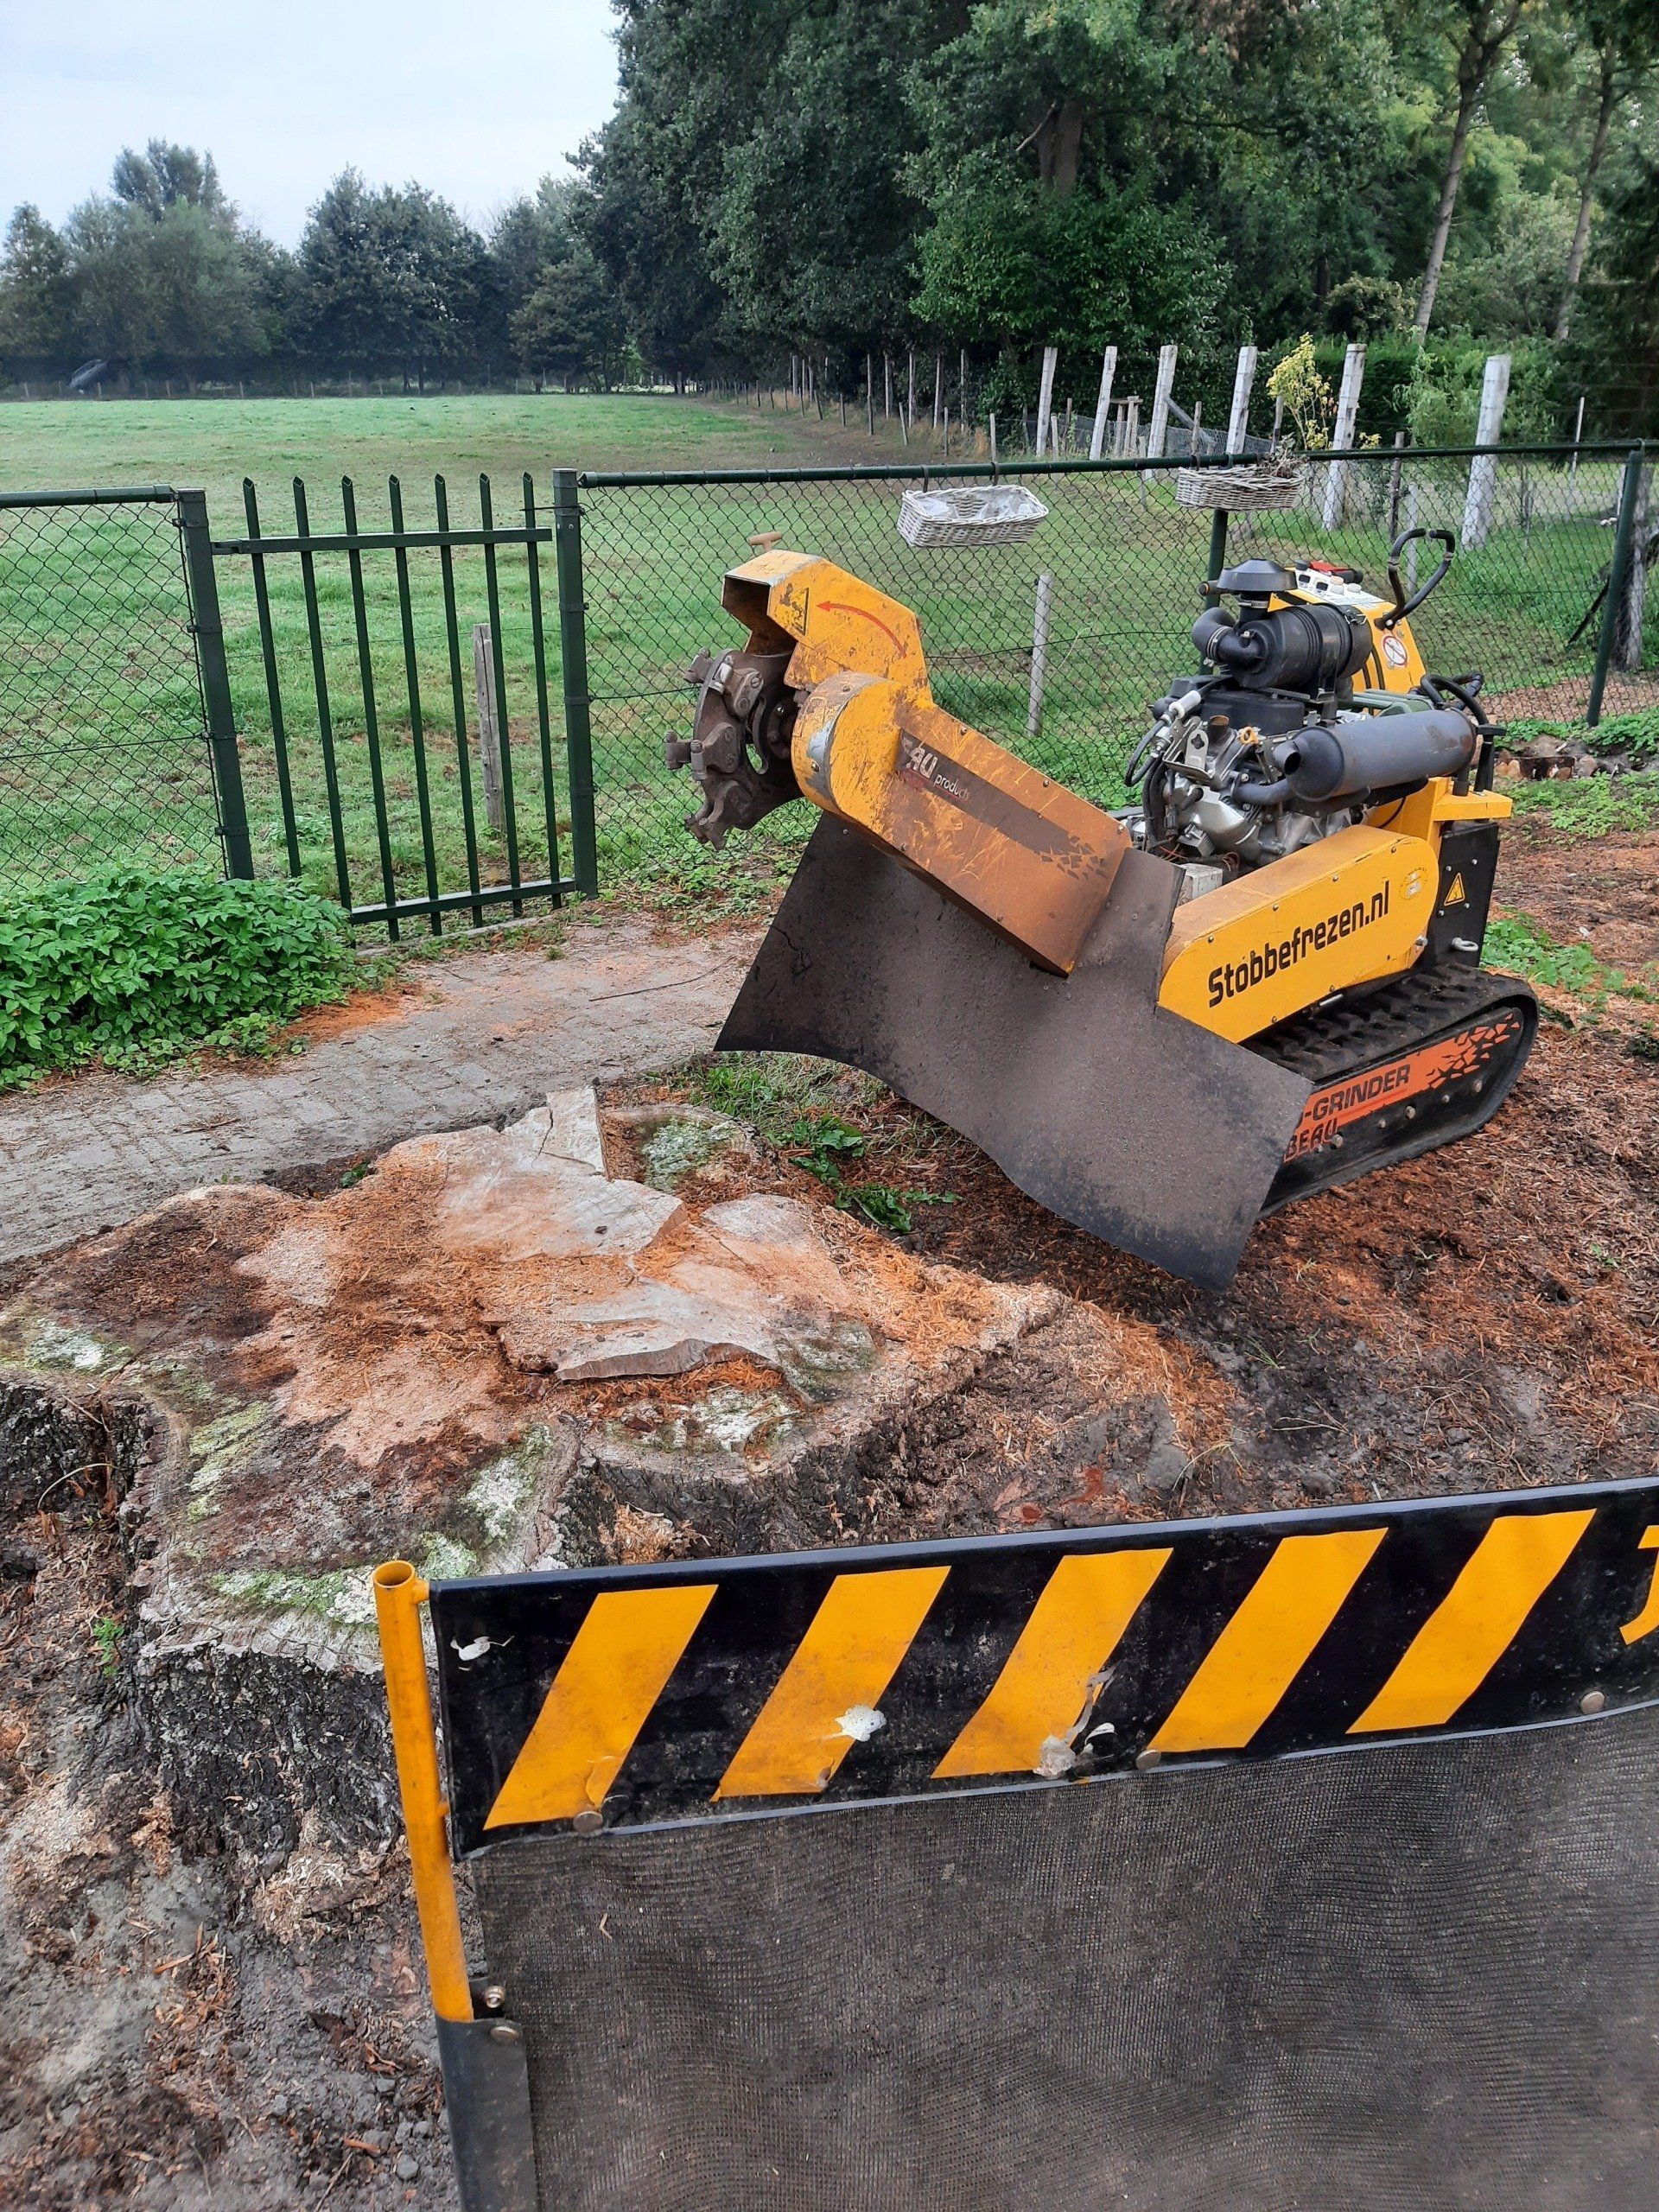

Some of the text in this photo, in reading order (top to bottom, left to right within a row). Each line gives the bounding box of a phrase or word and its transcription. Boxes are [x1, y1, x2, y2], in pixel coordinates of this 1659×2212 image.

[933, 773, 969, 801] products
[1208, 880, 1389, 1007] Stobbefrezen.nl
[1297, 1064, 1410, 1124] -GRINDER
